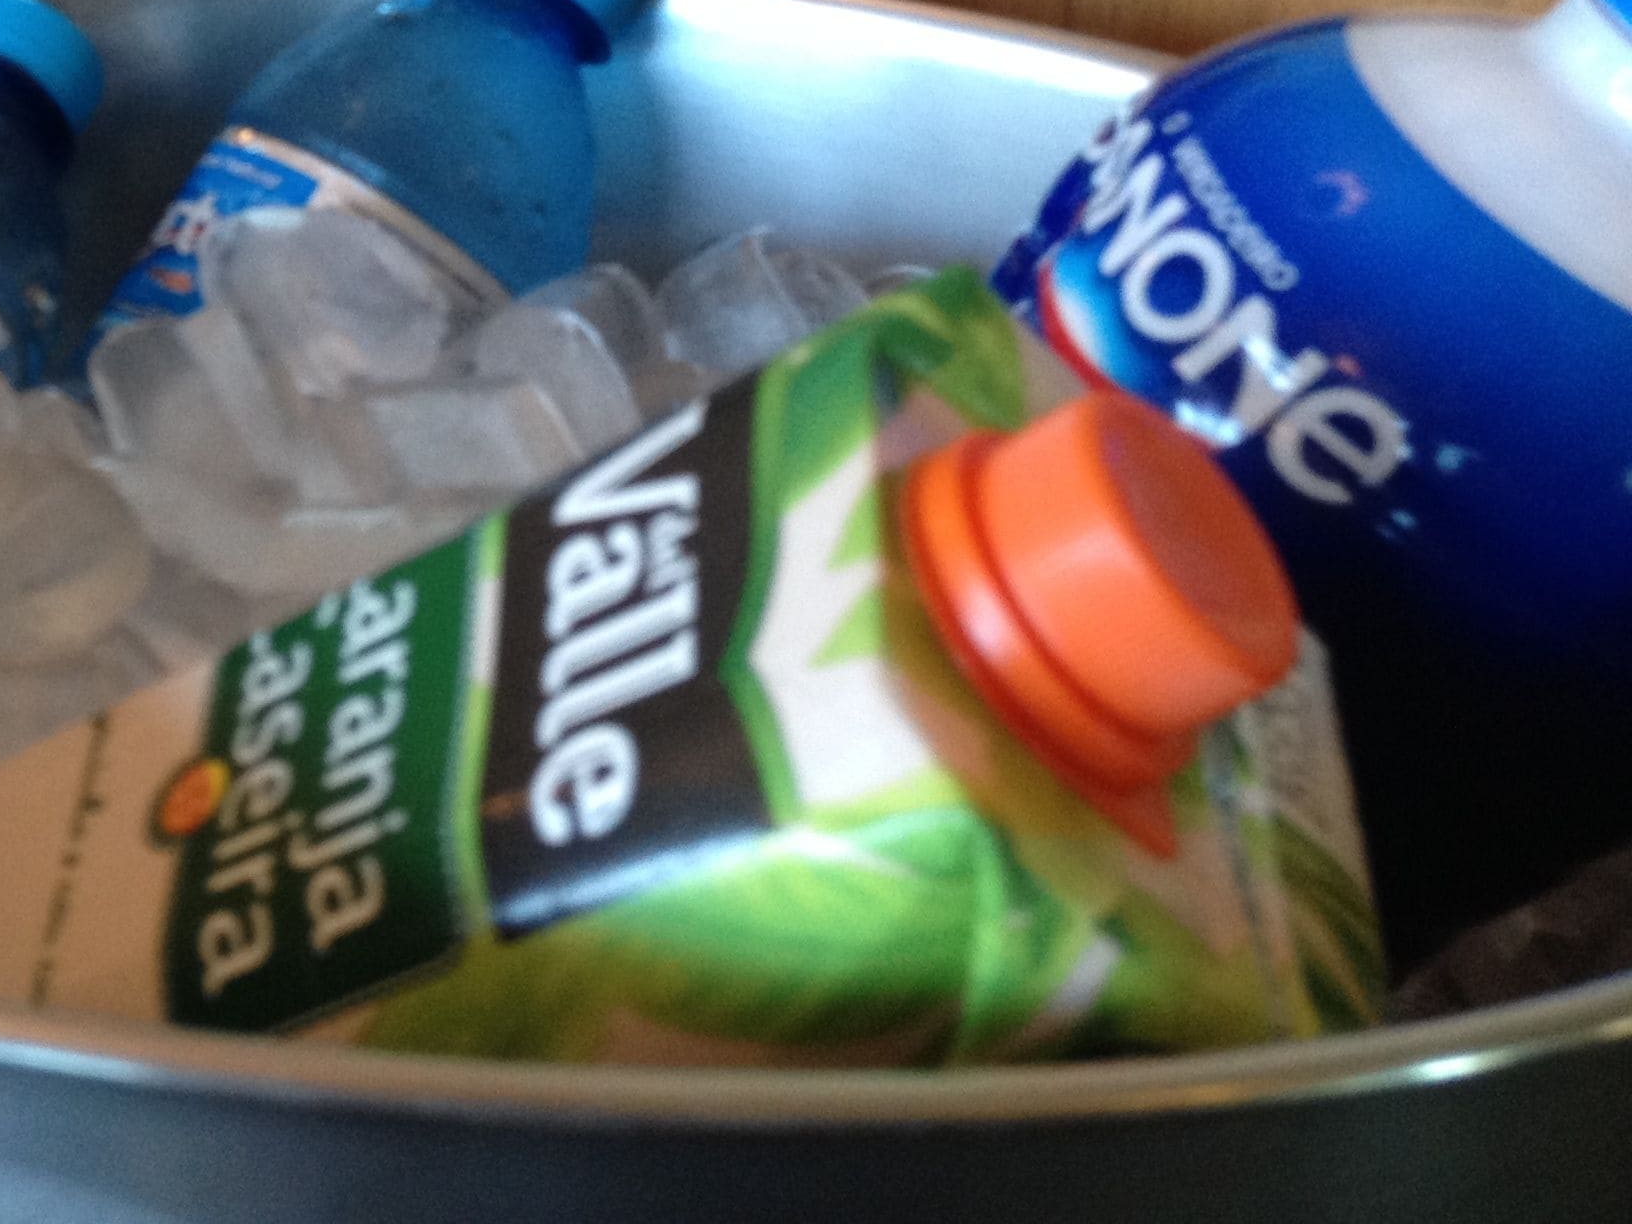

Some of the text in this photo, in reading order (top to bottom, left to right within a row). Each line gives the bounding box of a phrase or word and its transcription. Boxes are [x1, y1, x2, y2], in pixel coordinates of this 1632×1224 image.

[301, 577, 416, 951] aranja
[529, 394, 710, 847] Valle
[195, 626, 312, 998] aseira
